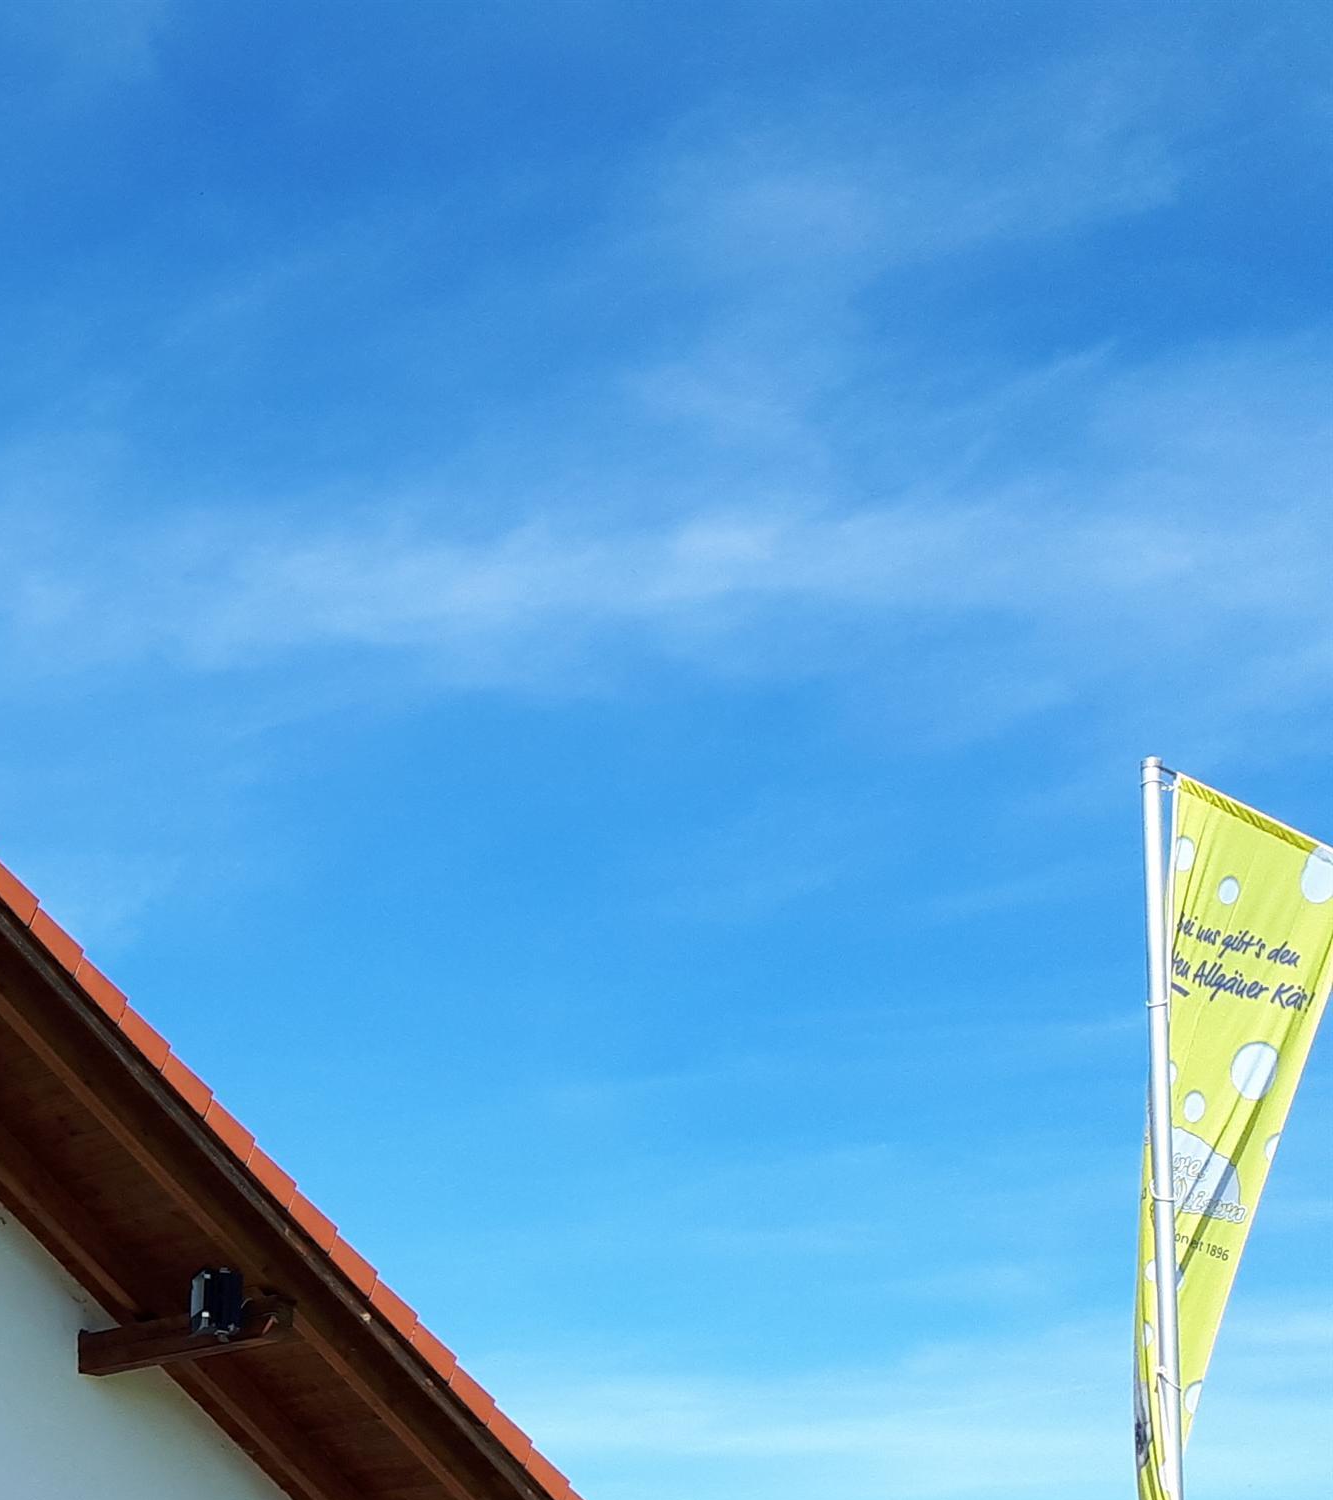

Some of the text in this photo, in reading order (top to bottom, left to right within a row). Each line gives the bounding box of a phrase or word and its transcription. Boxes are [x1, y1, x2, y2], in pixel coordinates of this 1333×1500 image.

[1196, 924, 1221, 946] uns
[1218, 930, 1266, 959] gibt's
[1267, 941, 1301, 968] den
[1192, 960, 1269, 1002] Allgäuer
[1206, 1243, 1230, 1261] 1896
